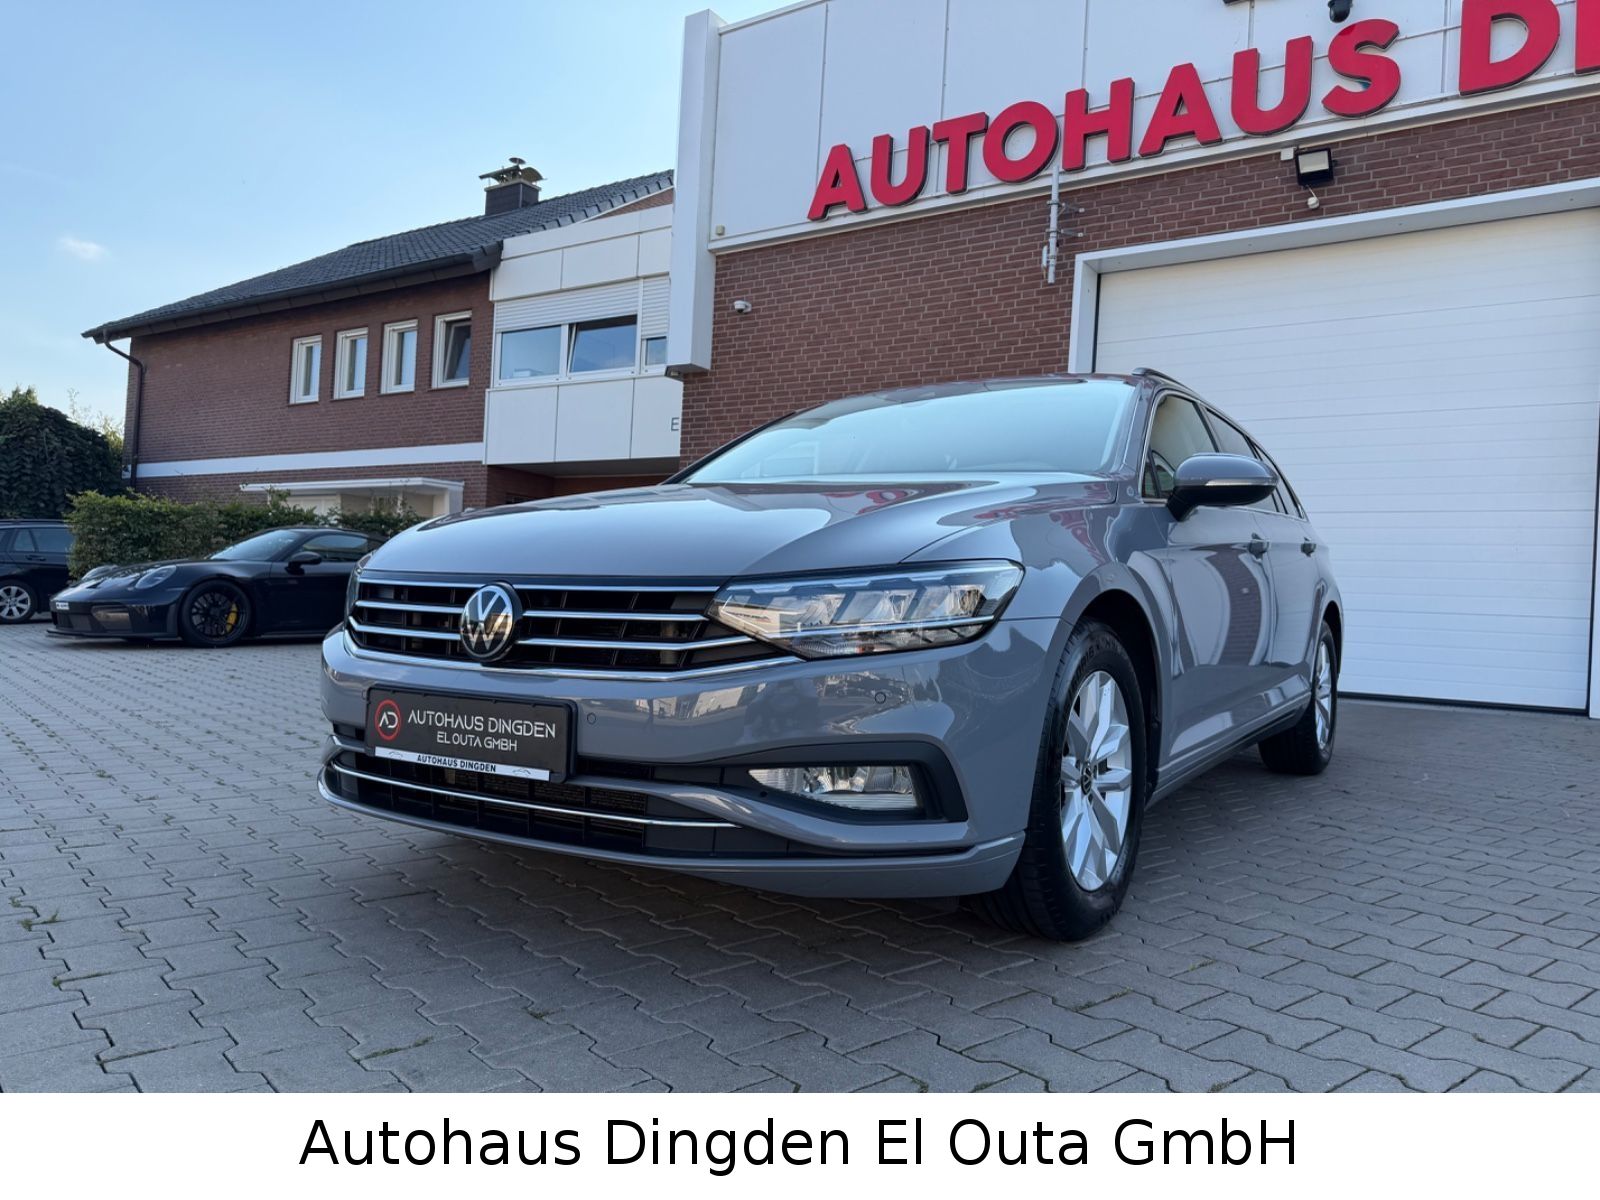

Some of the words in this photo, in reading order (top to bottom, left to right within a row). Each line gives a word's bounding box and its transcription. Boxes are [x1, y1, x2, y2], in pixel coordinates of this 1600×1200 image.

[807, 18, 1401, 221] AUTOHAUS
[407, 709, 485, 732] AUTOHAUS
[487, 716, 556, 739] DINGDEN
[436, 731, 450, 744] EL
[452, 734, 482, 748] OUTA
[484, 738, 518, 752] GMBH
[416, 754, 459, 768] AUTOHAUS
[459, 760, 497, 773] DINGDEN
